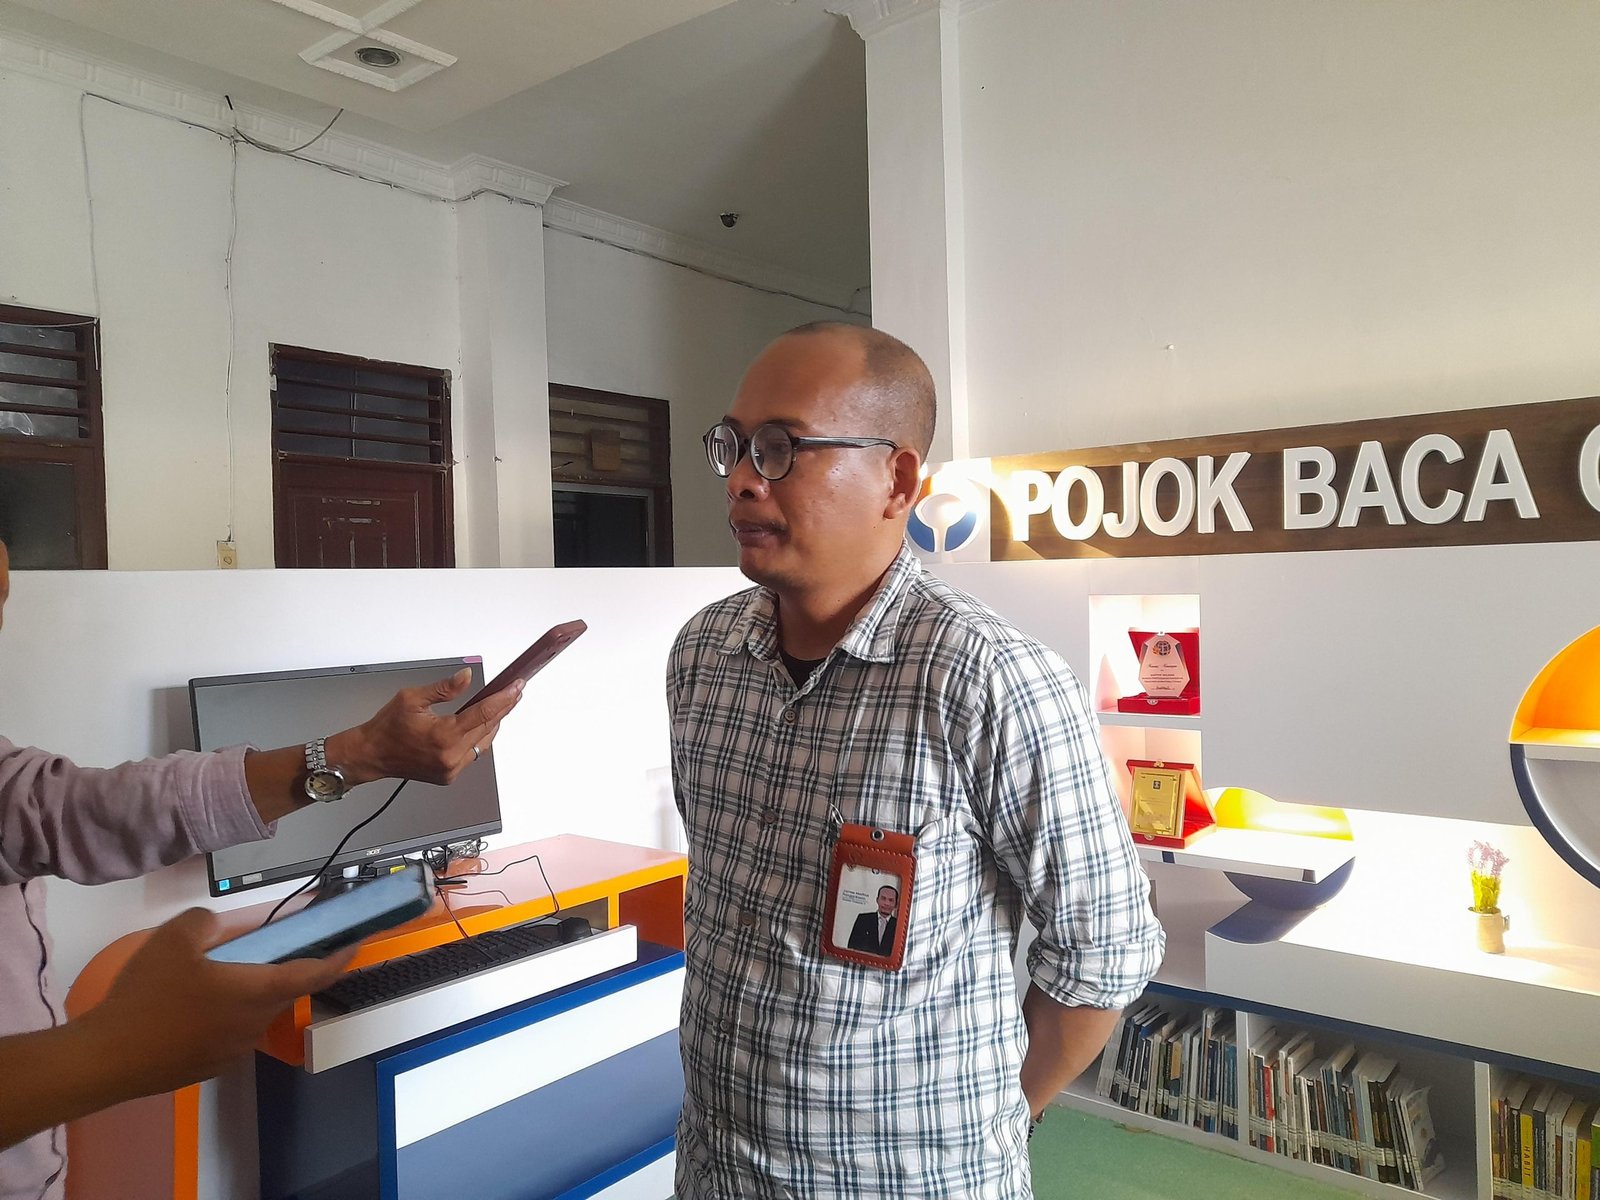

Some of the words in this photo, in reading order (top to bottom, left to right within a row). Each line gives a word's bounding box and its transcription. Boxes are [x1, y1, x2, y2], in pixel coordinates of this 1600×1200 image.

[1010, 452, 1253, 541] POJOK
[1283, 429, 1541, 530] BACA
[1523, 1145, 1532, 1177] HABIT
